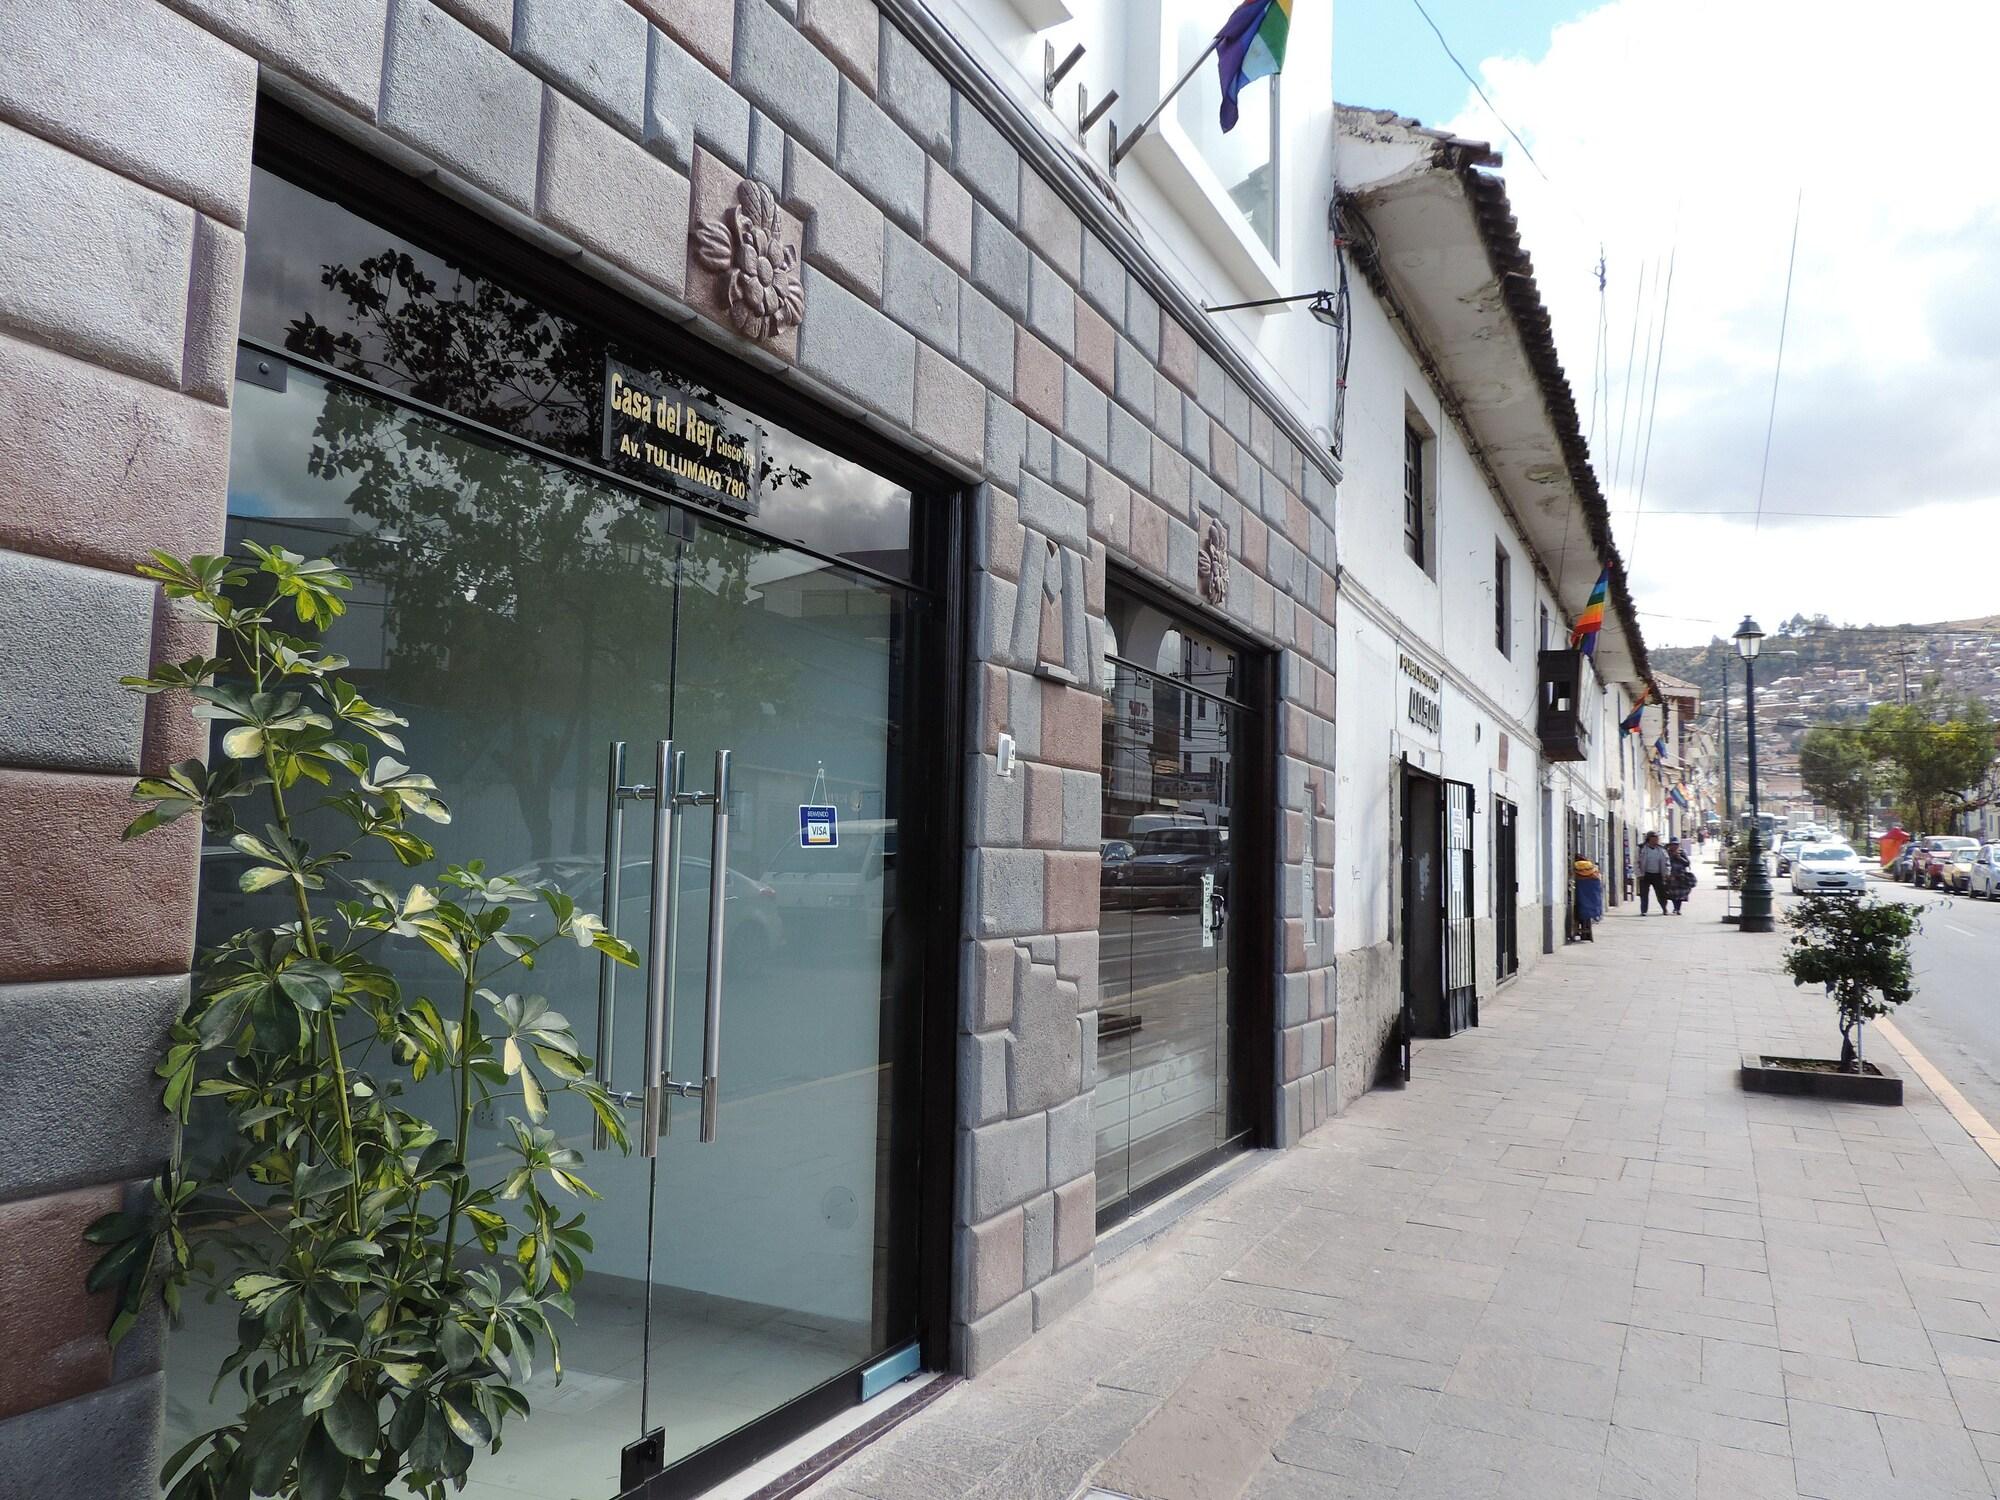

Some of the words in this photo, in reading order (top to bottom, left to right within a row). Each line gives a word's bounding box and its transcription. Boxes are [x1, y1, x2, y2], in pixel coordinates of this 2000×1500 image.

[610, 372, 652, 424] Casa
[656, 395, 682, 437] del
[685, 406, 716, 458] Rey
[716, 435, 742, 462] Cusco
[619, 434, 641, 460] Av.
[644, 442, 722, 490] TULLUMAYO
[725, 475, 746, 500] 780
[811, 825, 828, 836] VISA
